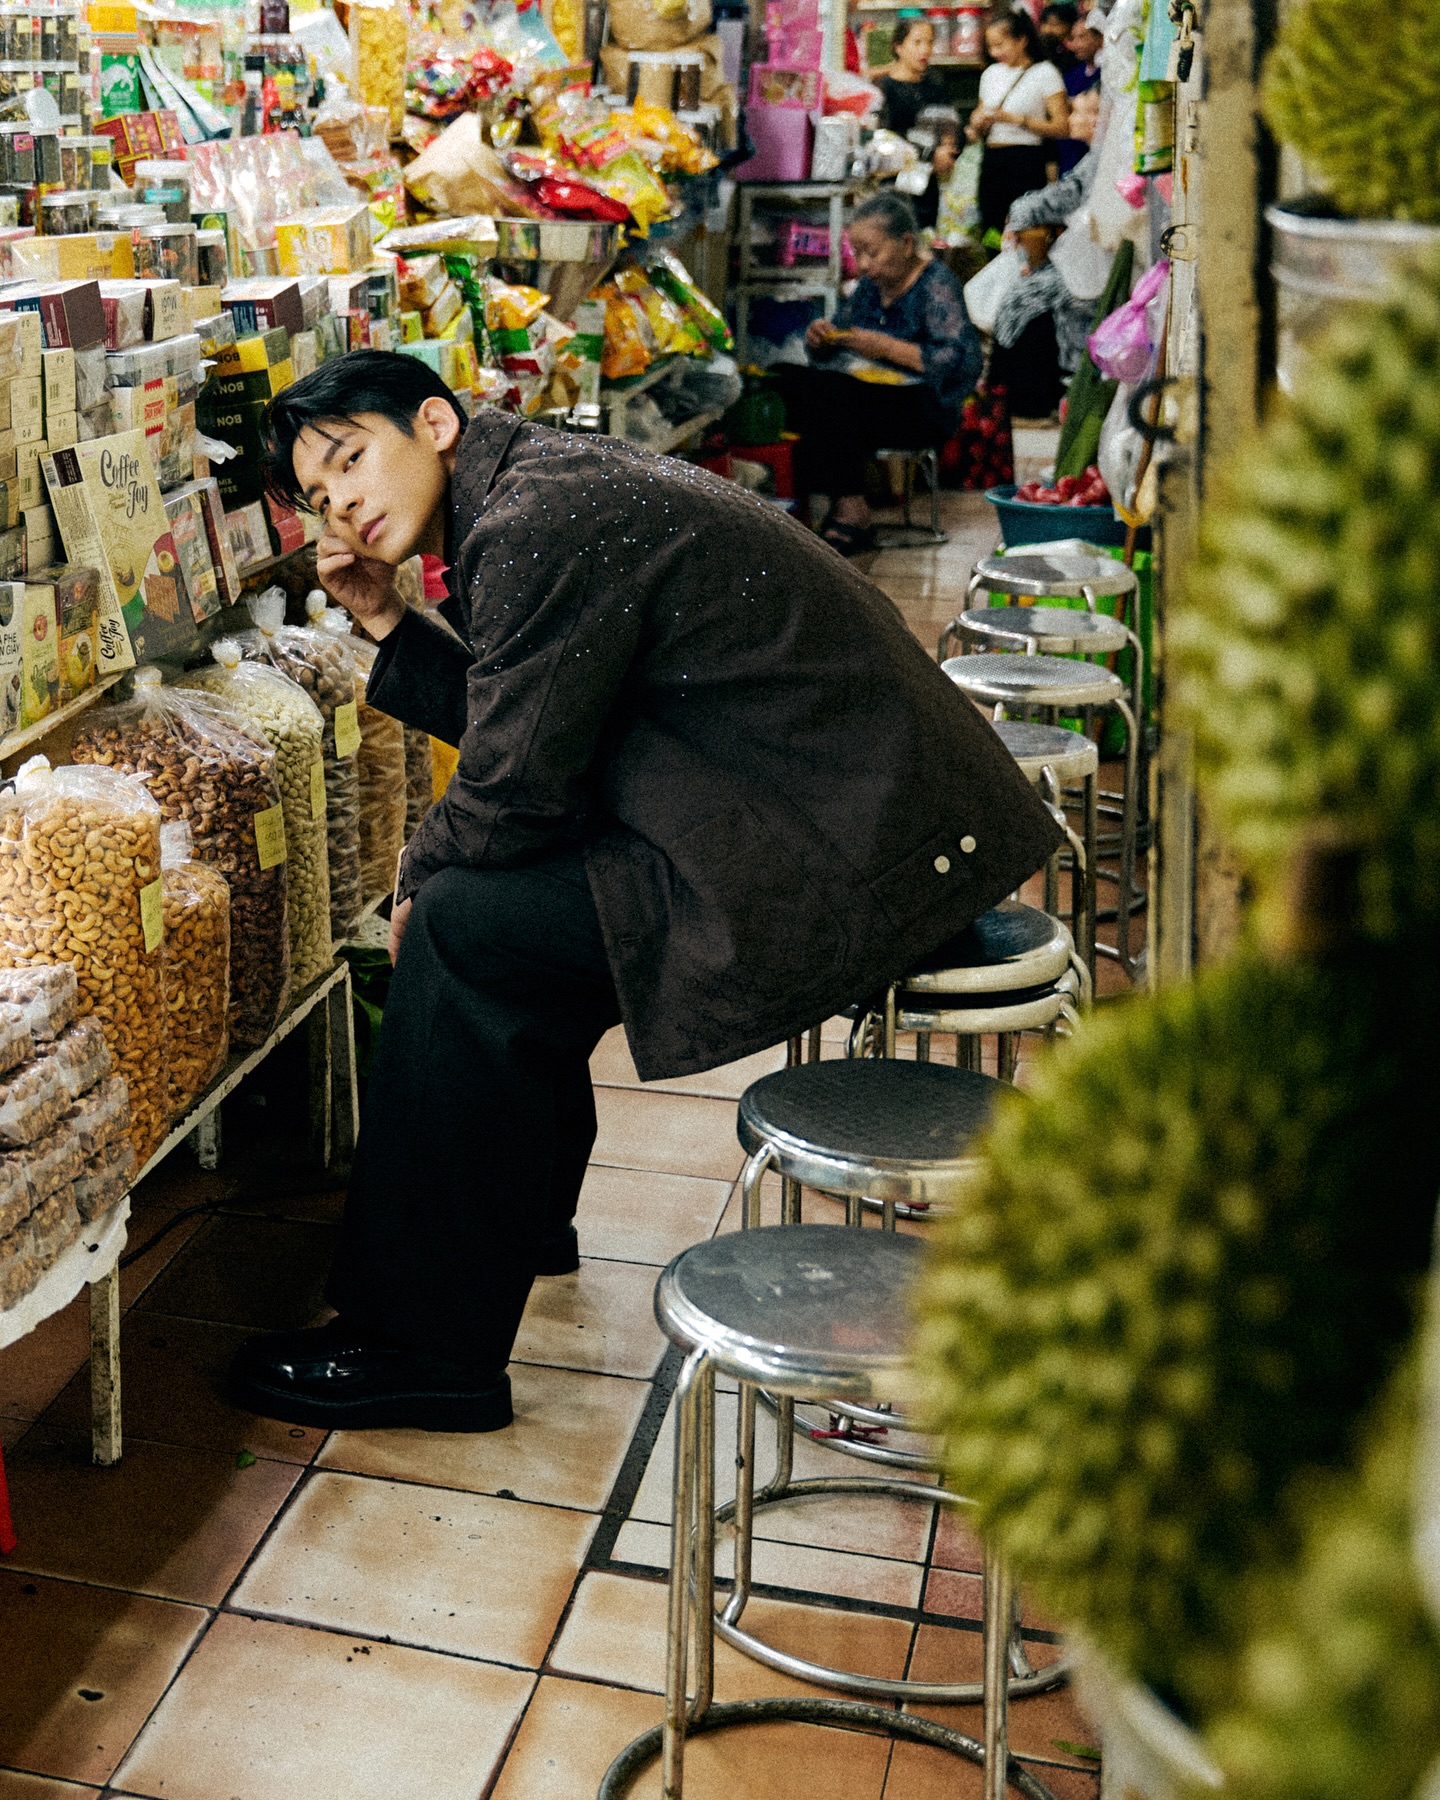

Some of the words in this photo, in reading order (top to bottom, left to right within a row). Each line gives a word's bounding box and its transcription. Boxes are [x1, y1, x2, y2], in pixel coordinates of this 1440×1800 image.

[216, 351, 241, 363] BON
[218, 381, 245, 396] BON
[216, 414, 242, 427] BON
[100, 449, 140, 489] Coffee
[219, 485, 238, 494] FFEE
[126, 480, 149, 519] Joy
[108, 619, 125, 642] Joy
[99, 623, 116, 660] Coffee
